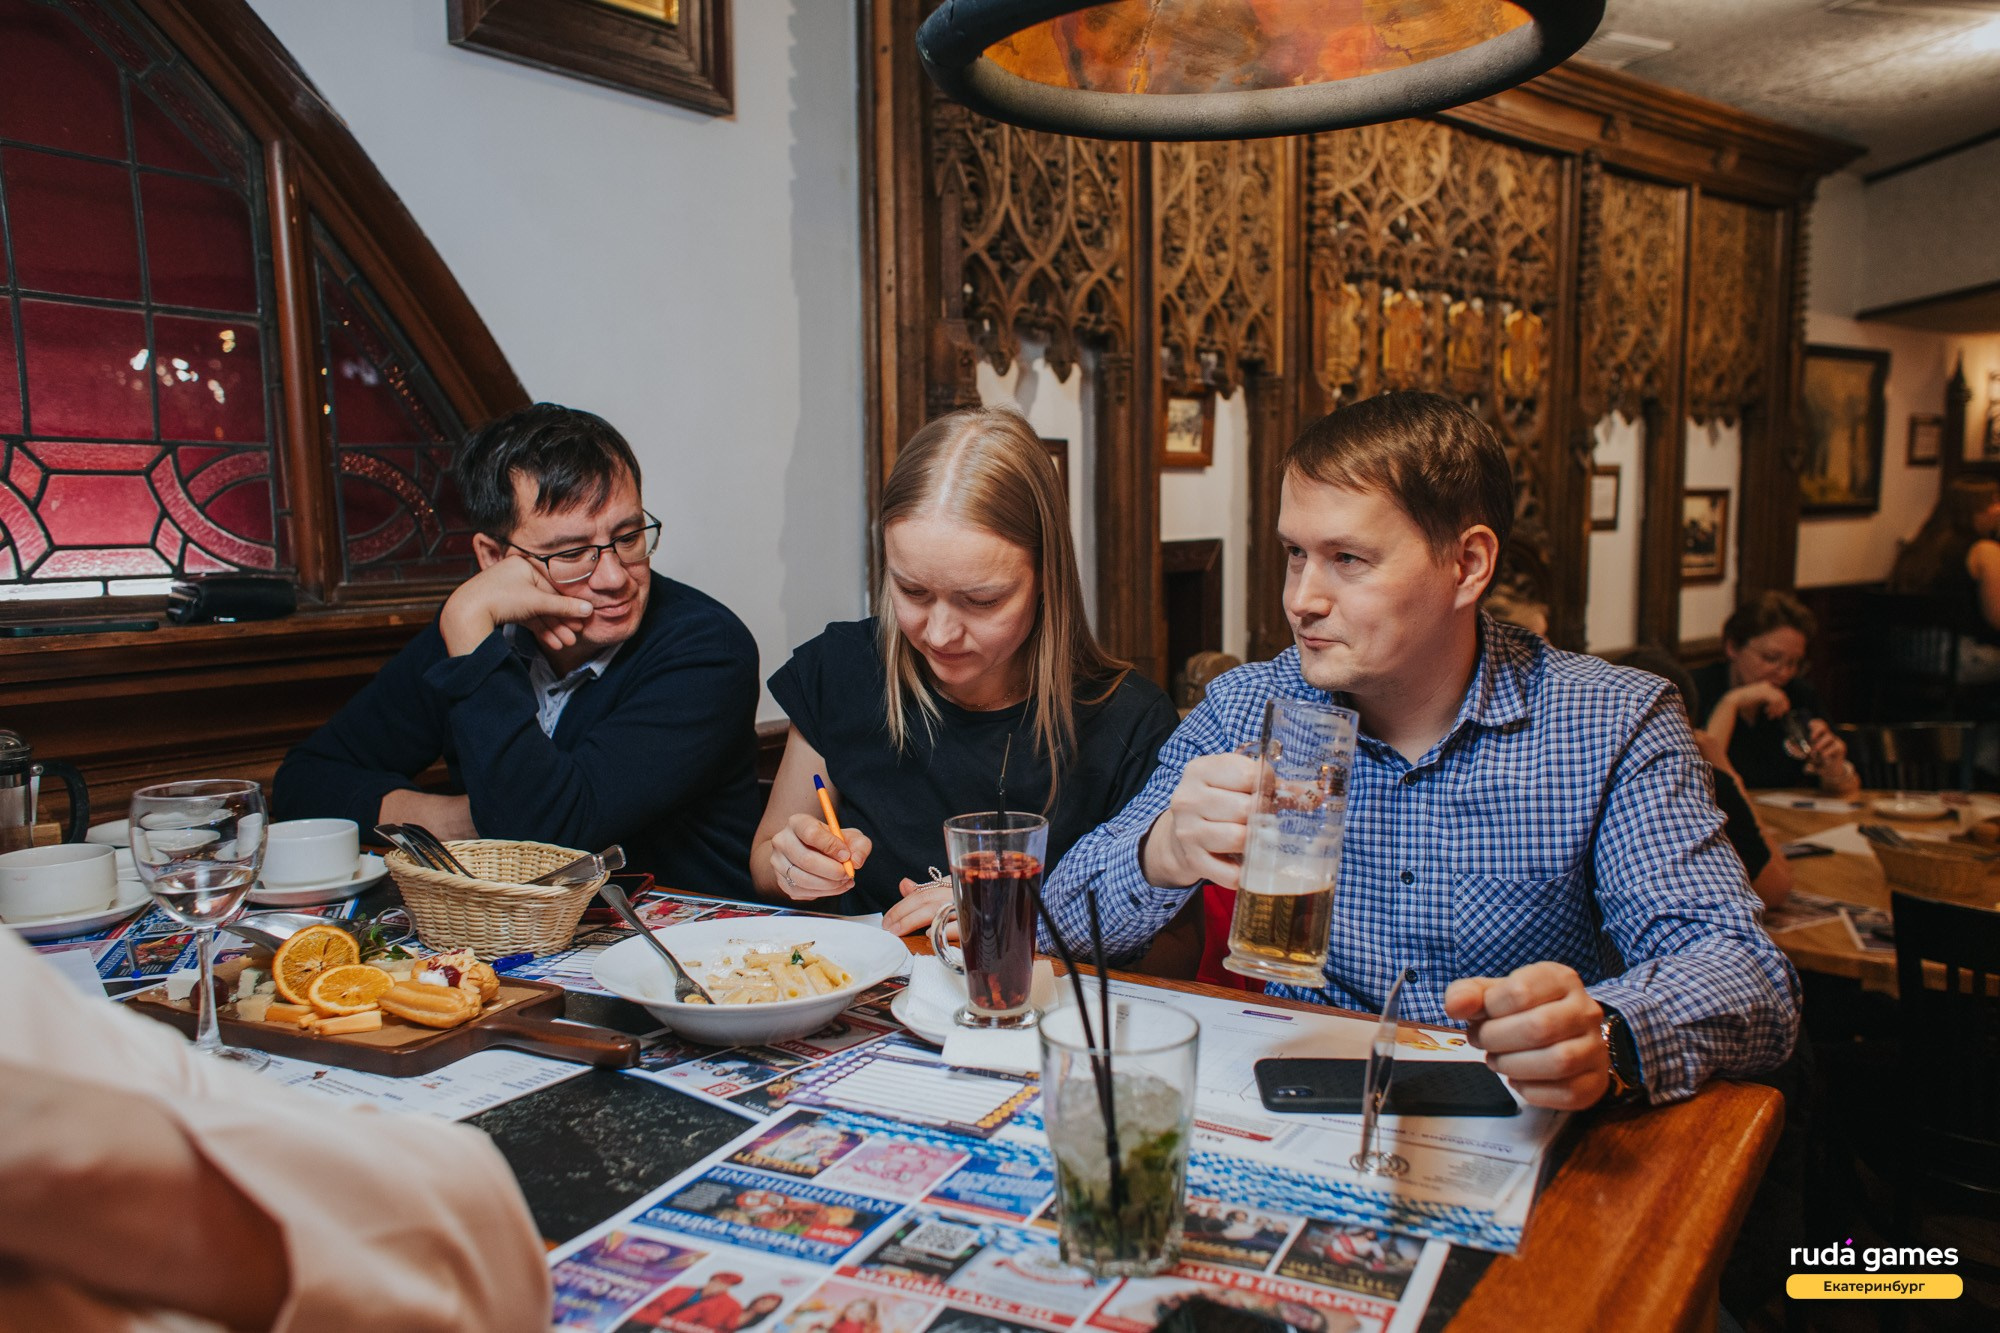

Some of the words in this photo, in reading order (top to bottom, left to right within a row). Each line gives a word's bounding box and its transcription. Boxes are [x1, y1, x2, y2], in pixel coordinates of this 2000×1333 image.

[707, 1166, 898, 1214] ИМЕНИННИКАМ
[645, 1207, 730, 1234] СКИДКА
[1257, 1278, 1389, 1318] ПОДАРОК
